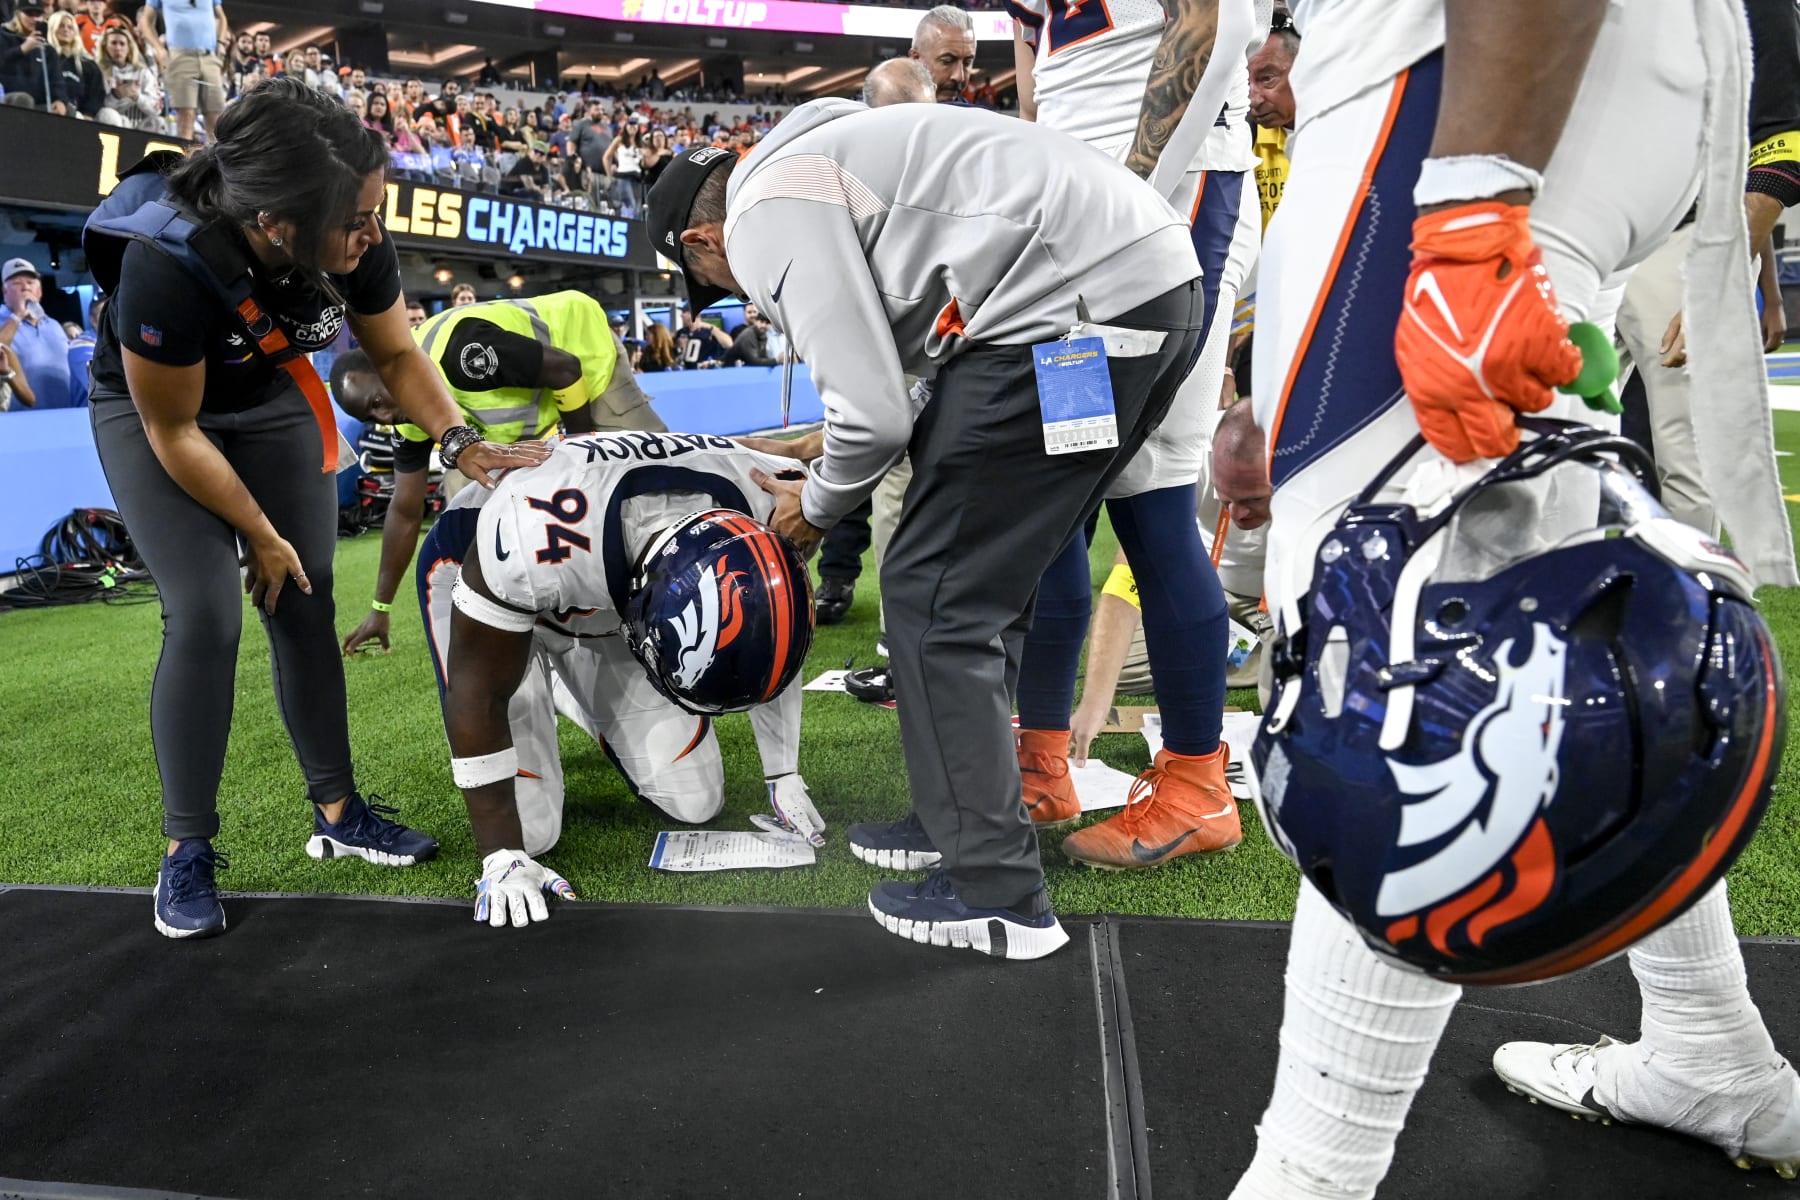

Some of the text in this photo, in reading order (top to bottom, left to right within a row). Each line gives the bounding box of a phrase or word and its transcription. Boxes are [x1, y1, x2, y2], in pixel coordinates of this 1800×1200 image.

[466, 197, 629, 258] CHARGERS
[1053, 351, 1099, 363] CHARGERS
[526, 488, 592, 565] 94
